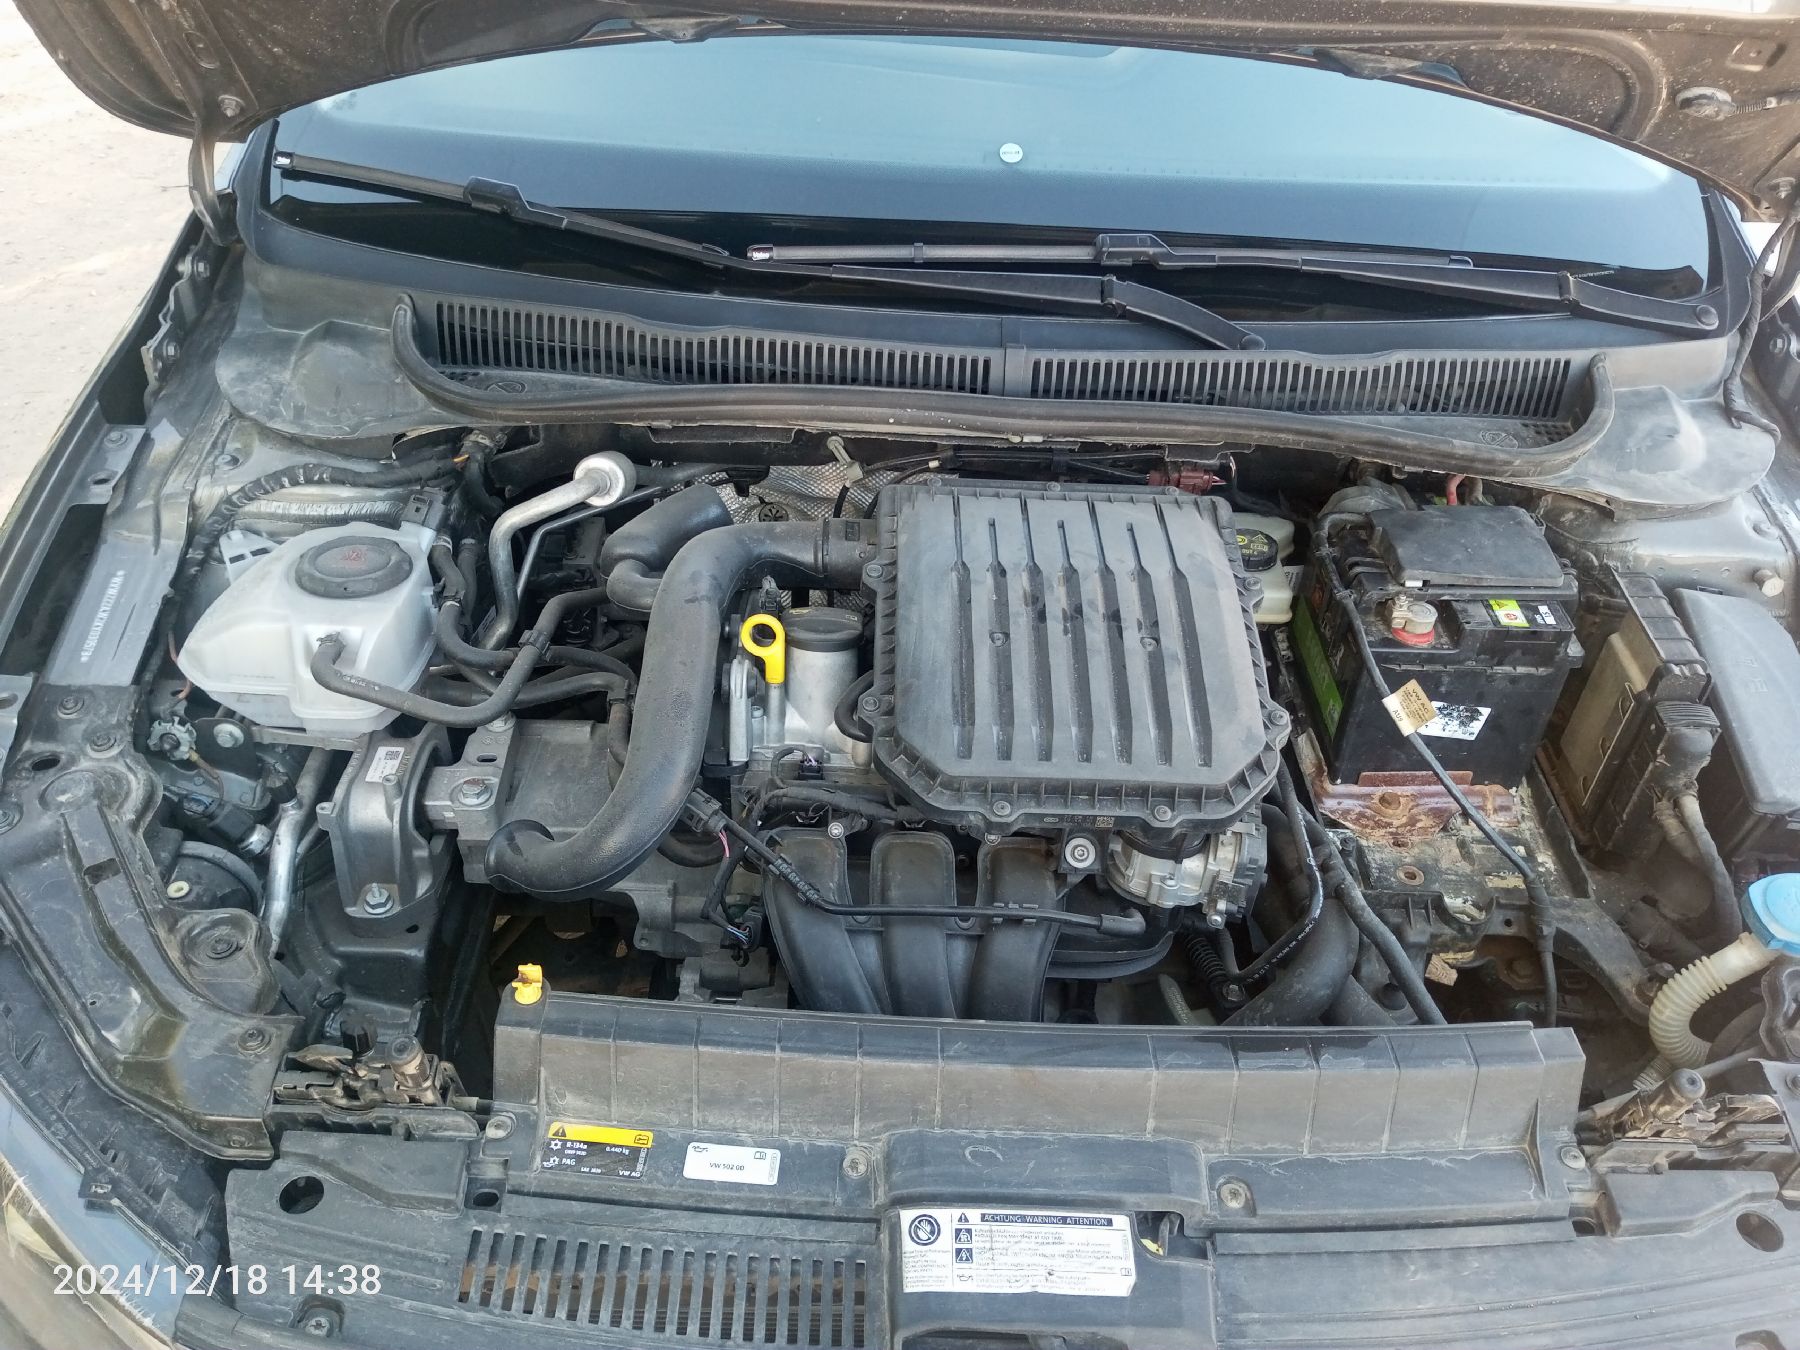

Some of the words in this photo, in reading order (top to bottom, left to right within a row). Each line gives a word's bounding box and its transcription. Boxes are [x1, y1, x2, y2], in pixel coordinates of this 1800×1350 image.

[983, 1214, 1022, 1223] ACHTUNG
[1026, 1215, 1063, 1224] WARNING
[1066, 1217, 1108, 1226] ATTENTION
